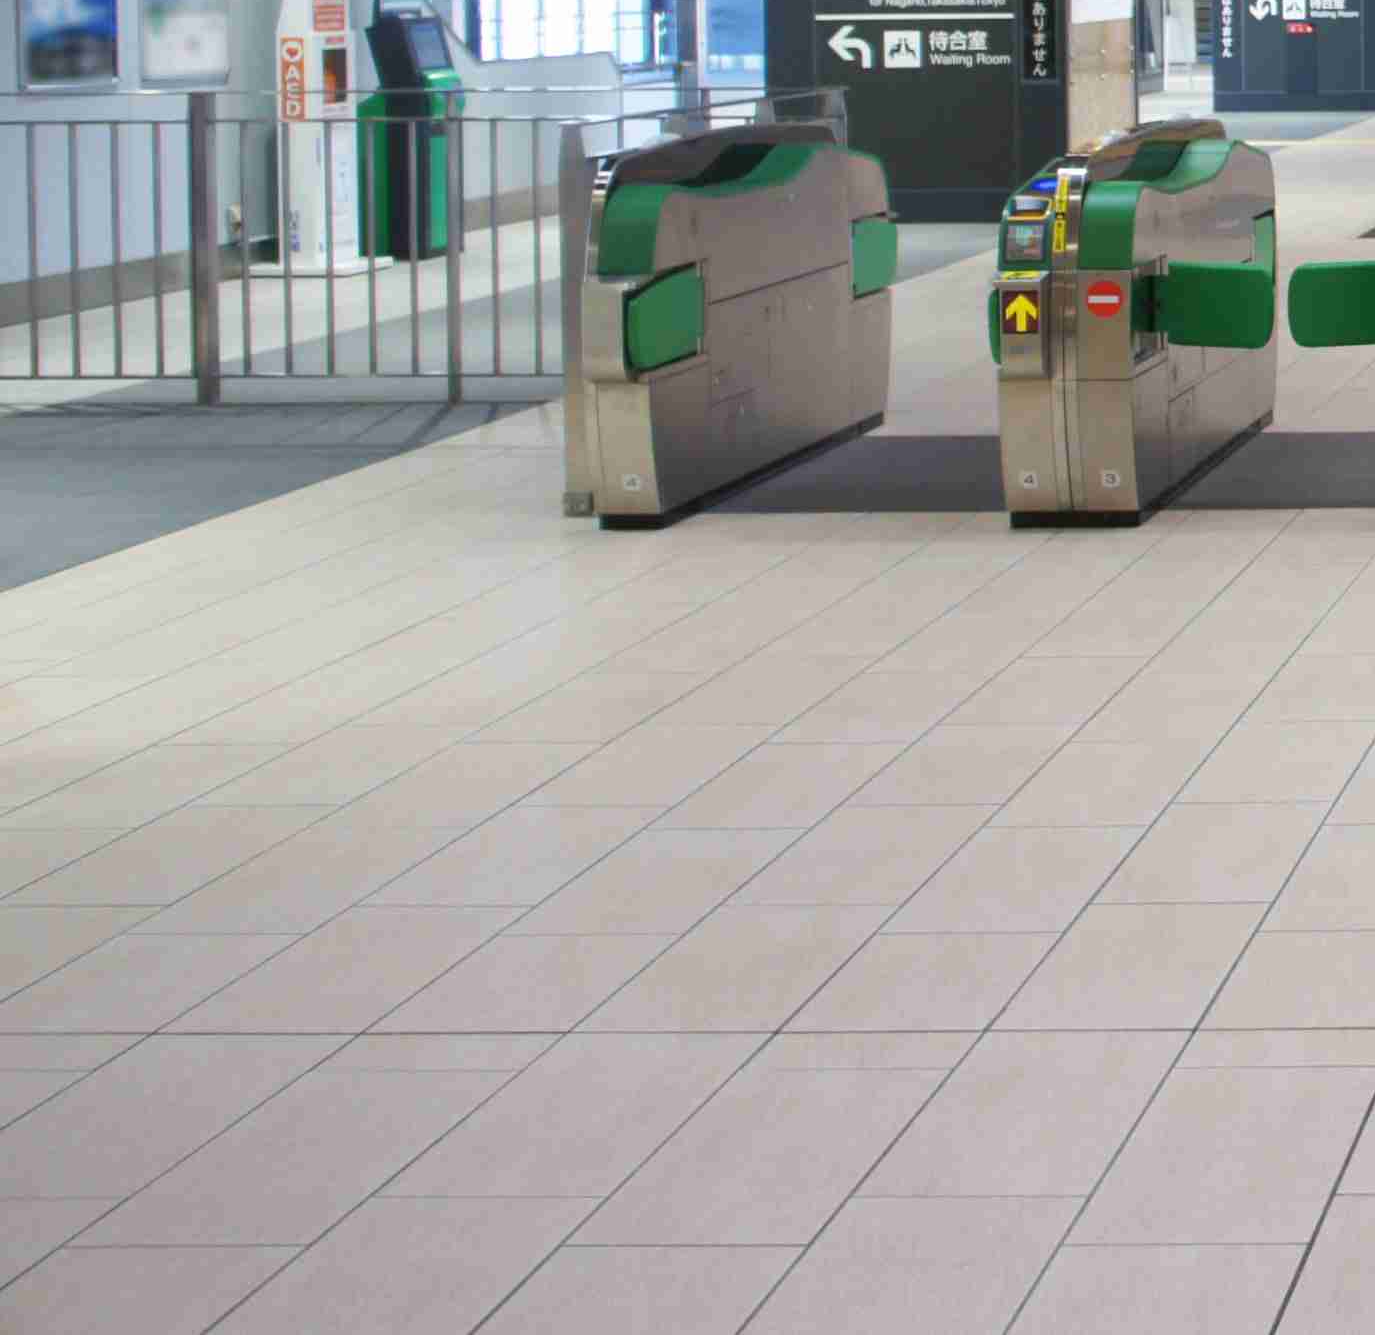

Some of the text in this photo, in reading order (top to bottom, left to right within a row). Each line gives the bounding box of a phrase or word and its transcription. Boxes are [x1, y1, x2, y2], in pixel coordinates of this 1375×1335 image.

[929, 31, 987, 51] 待合室
[976, 52, 1011, 66] Room
